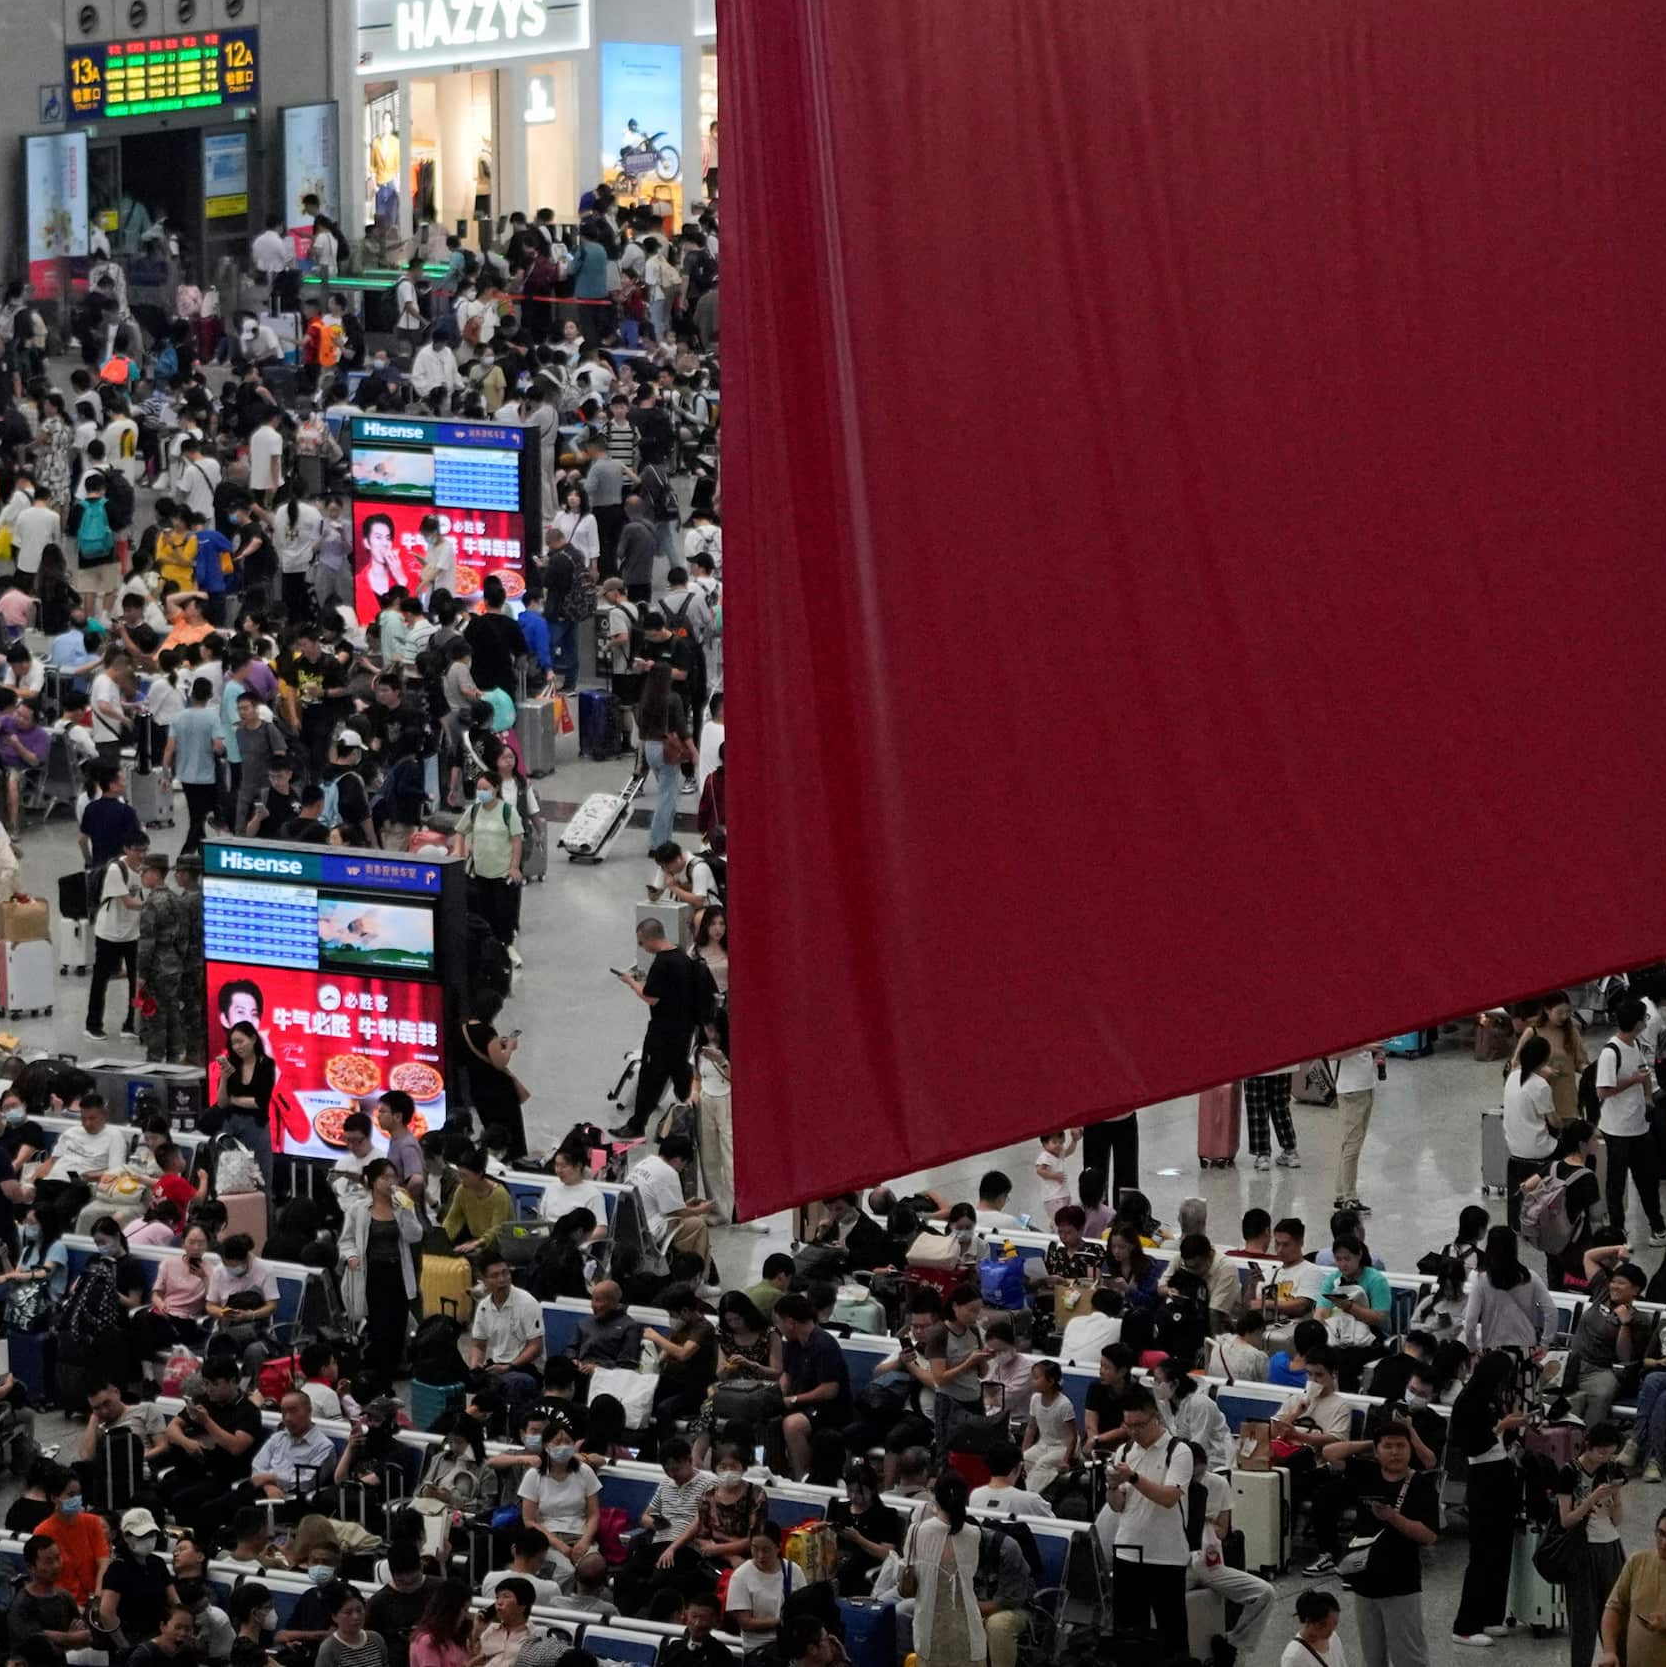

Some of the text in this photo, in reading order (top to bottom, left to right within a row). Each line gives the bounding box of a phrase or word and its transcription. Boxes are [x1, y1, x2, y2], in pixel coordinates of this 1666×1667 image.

[71, 41, 254, 84] 13A 12A
[362, 421, 424, 440] Hisense
[220, 850, 303, 876] Hisense
[344, 992, 389, 1013] 必胜客
[272, 1006, 352, 1039] 牛气必胜
